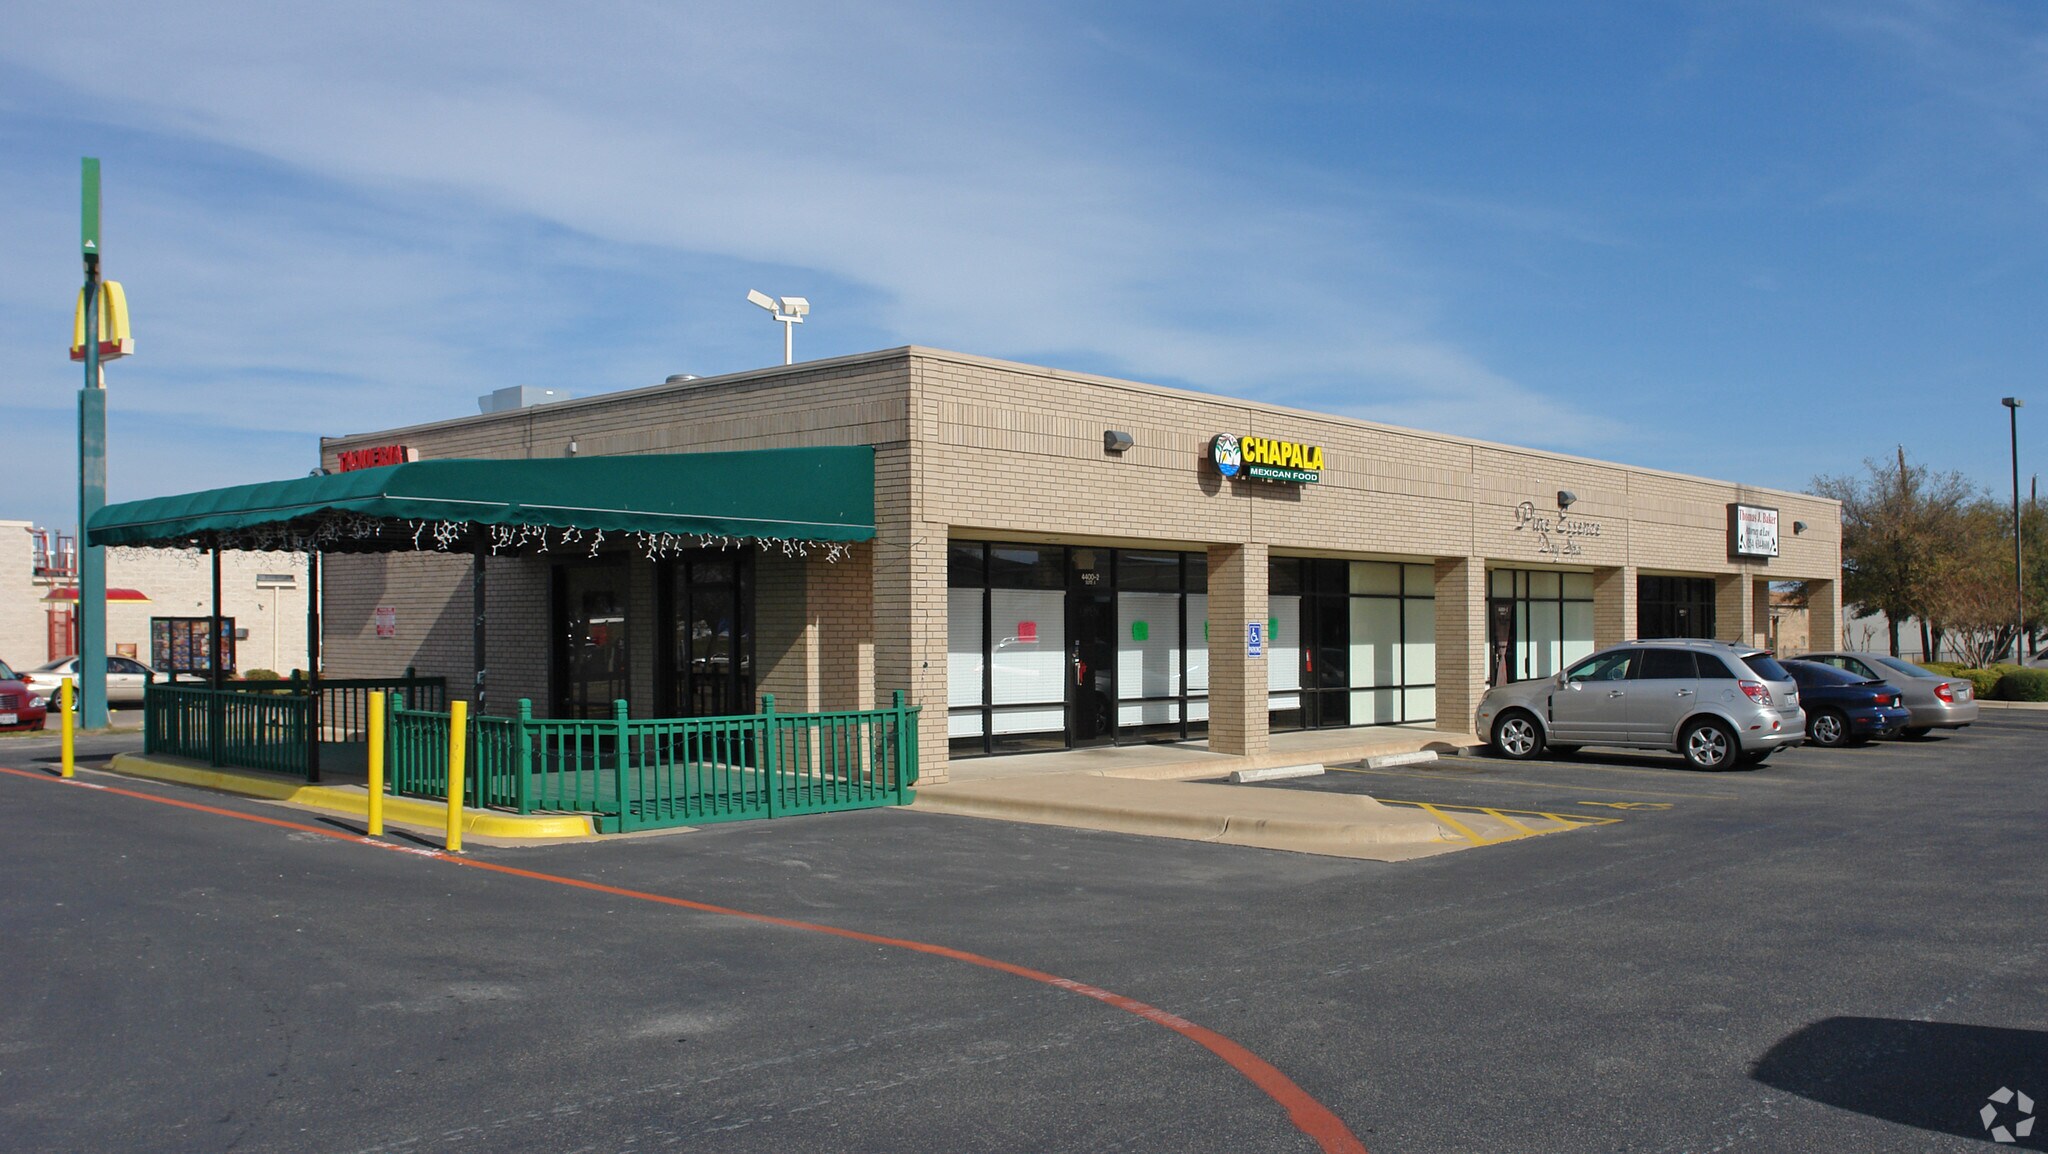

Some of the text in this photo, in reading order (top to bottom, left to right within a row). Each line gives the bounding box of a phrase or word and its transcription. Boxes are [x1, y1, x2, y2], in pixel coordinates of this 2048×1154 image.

[1241, 436, 1324, 470] CHAPALA
[1250, 467, 1318, 481] MEXICAN FOOD
[1739, 509, 1757, 522] Thomas
[1762, 513, 1776, 525] Baker
